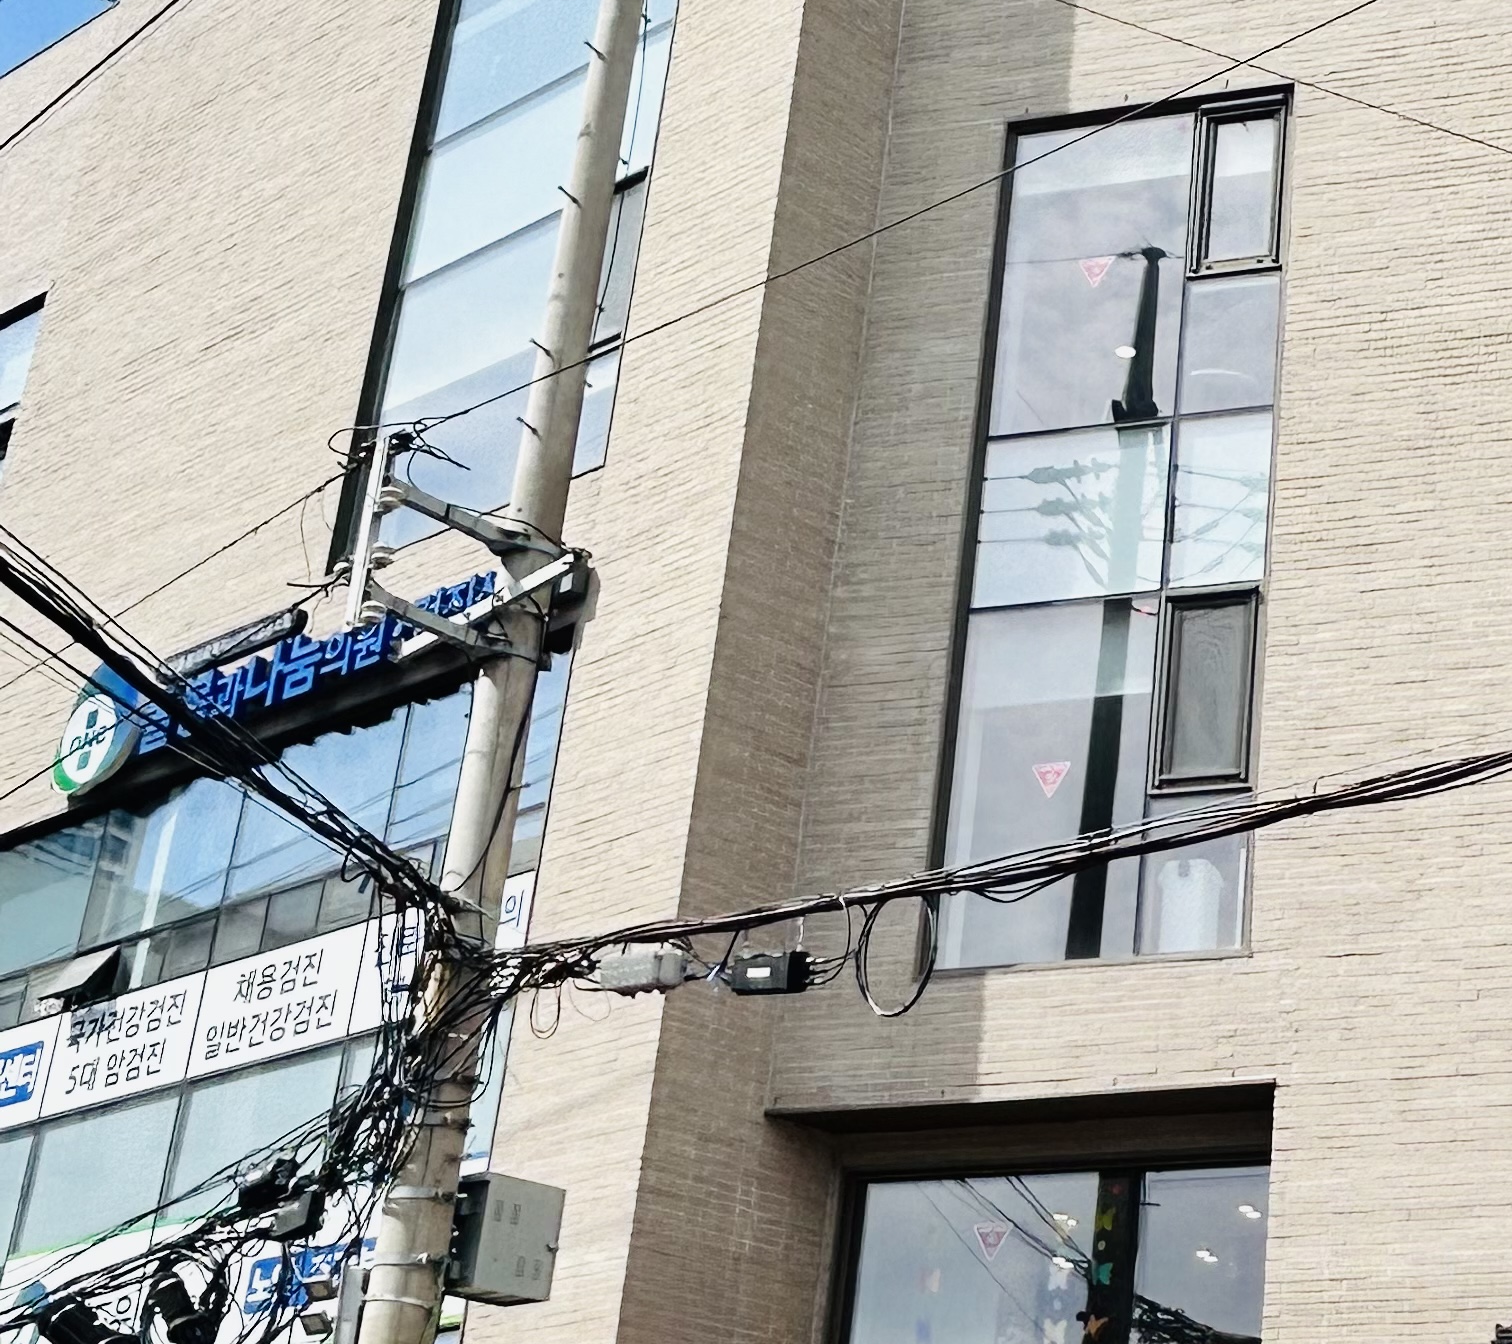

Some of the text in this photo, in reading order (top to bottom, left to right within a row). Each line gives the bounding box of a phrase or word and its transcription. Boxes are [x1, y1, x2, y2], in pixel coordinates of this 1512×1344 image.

[233, 948, 324, 1004] 채용검진
[205, 989, 338, 1060] 일반건강검진
[65, 1037, 167, 1095] 5대 암검진
